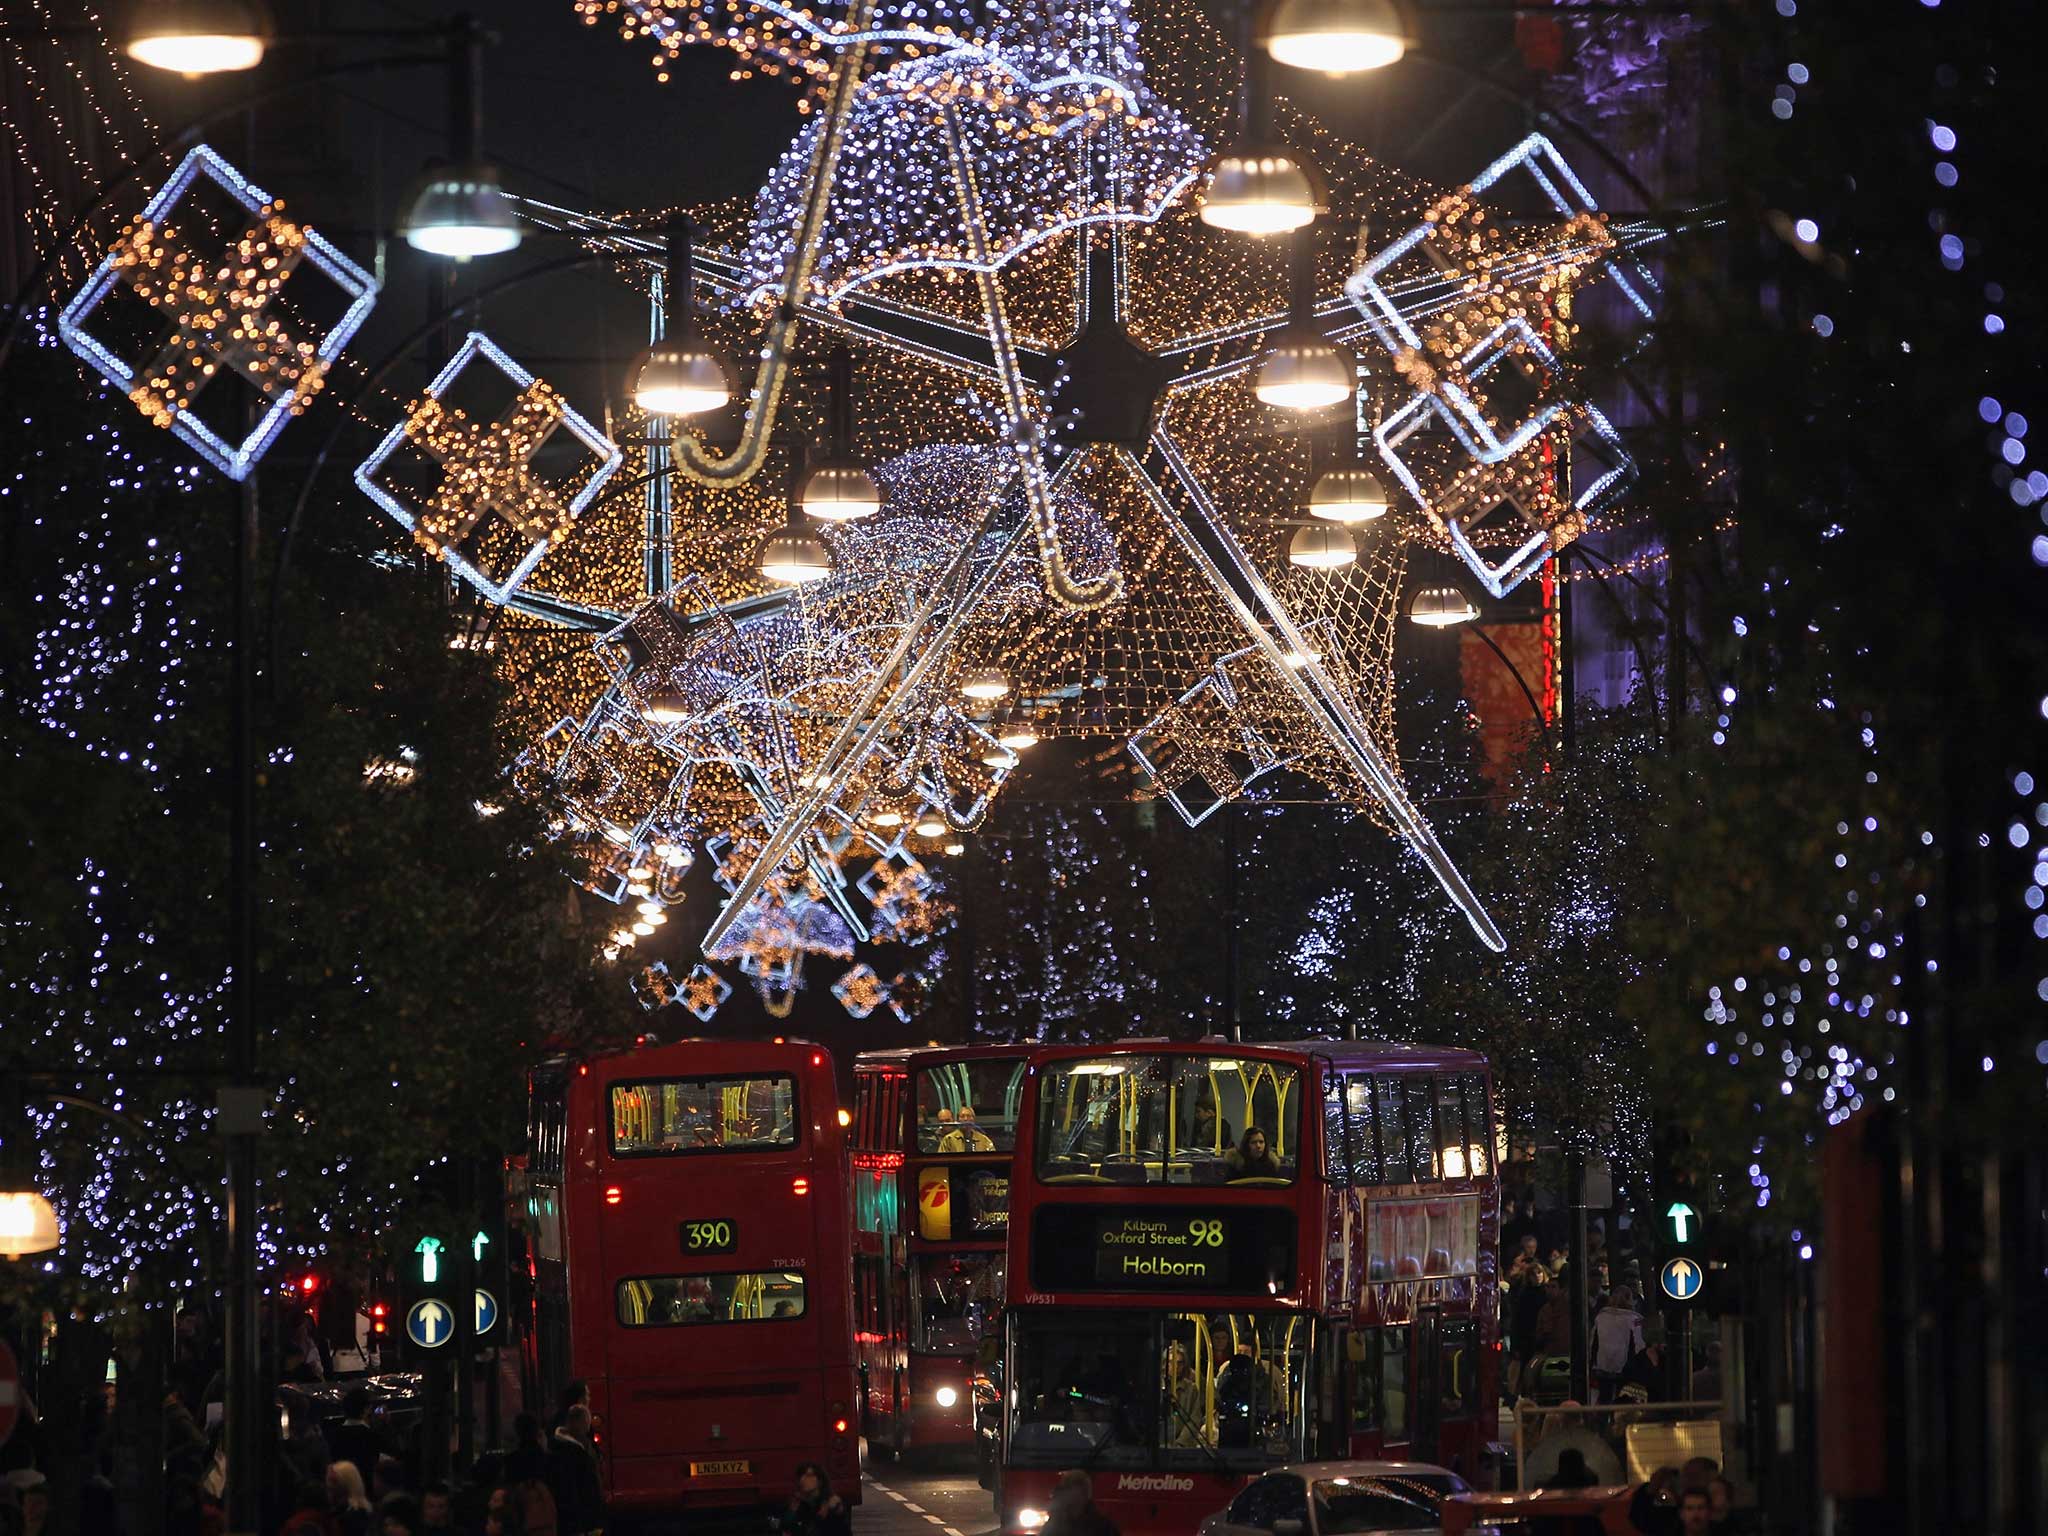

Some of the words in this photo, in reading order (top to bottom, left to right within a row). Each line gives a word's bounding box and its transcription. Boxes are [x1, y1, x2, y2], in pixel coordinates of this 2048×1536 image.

[1123, 1220, 1167, 1232] Kilburn
[1189, 1220, 1224, 1247] 98
[686, 1222, 731, 1249] 390
[1103, 1232, 1146, 1244] Oxford
[1150, 1233, 1187, 1245] Street
[772, 1258, 807, 1268] TPL265
[1123, 1255, 1206, 1277] Holborn
[1024, 1294, 1056, 1305] VP531
[1118, 1474, 1194, 1491] Metroline
